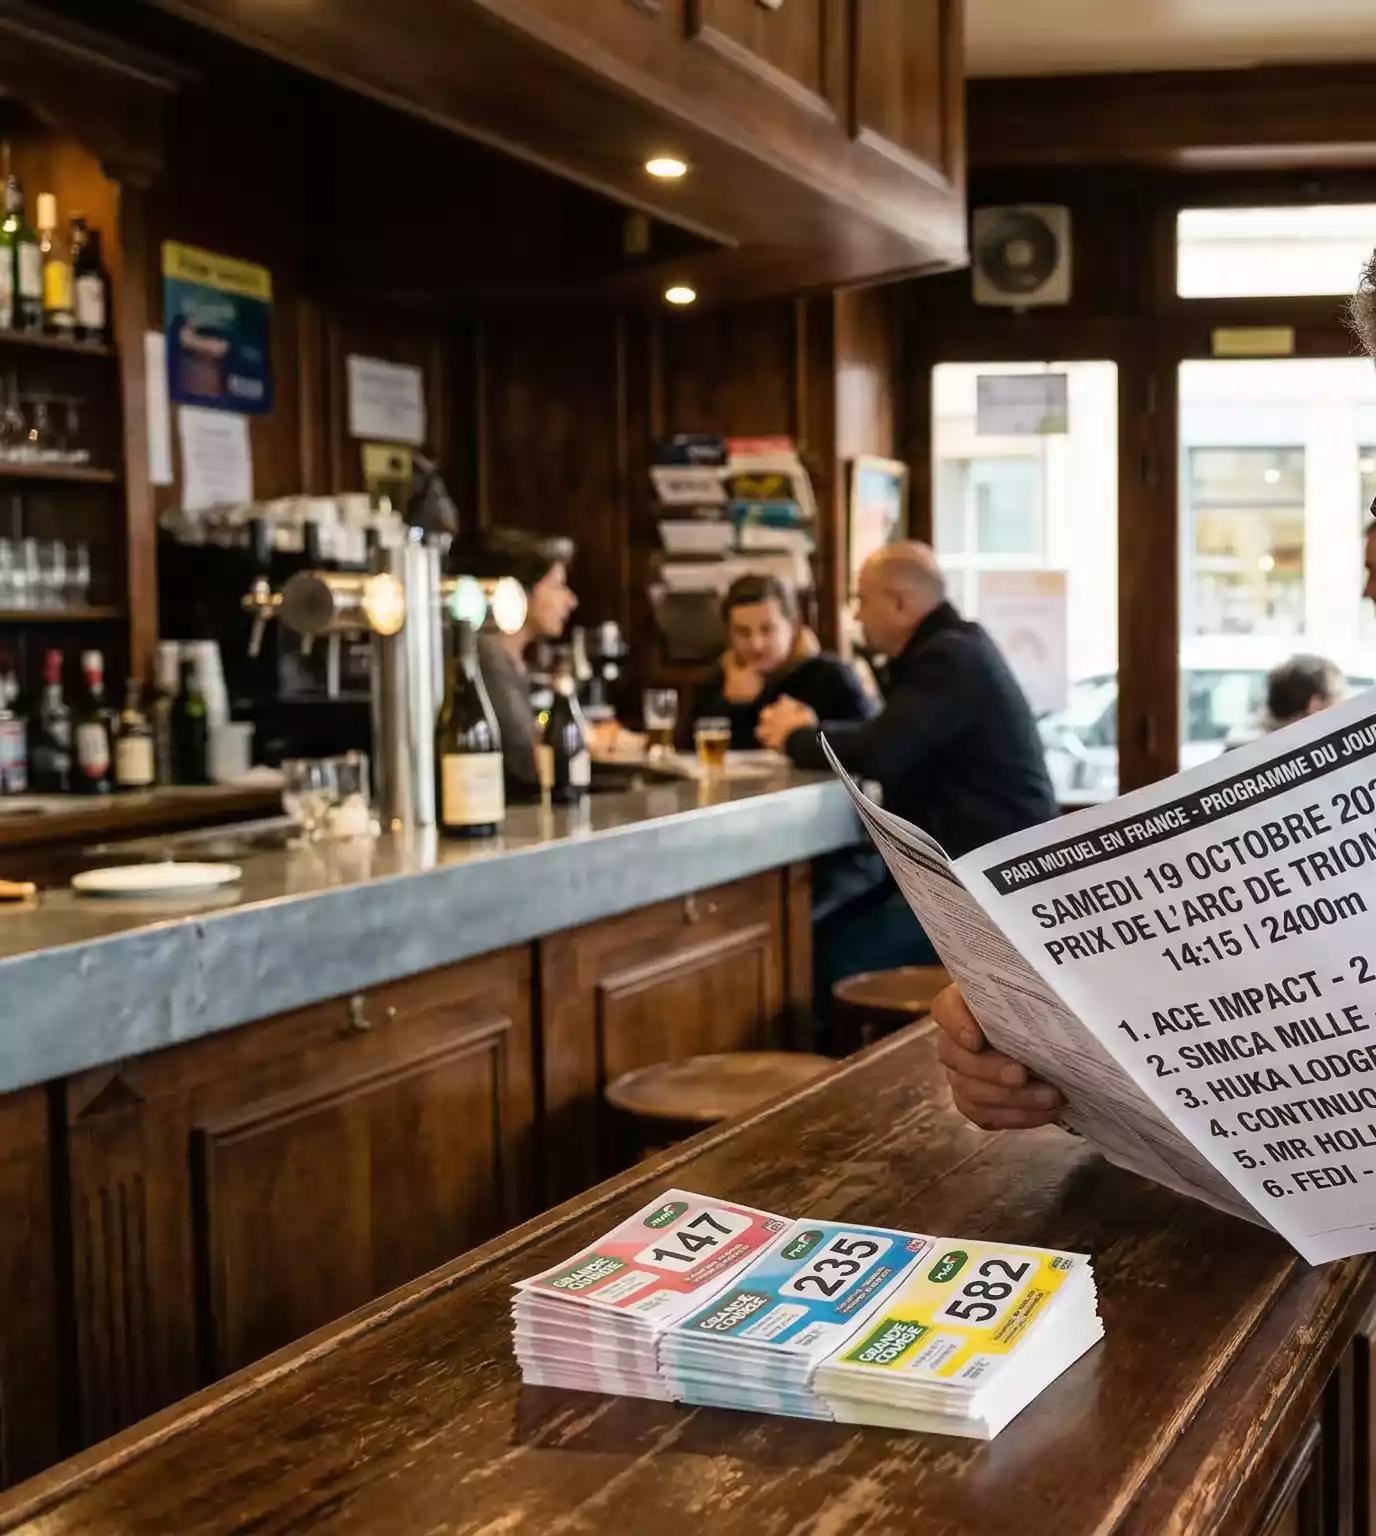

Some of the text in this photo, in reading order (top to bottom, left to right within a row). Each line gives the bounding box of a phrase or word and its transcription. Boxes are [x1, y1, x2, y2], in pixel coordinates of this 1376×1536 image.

[1001, 861, 1039, 886] PARI
[1038, 841, 1101, 873] MUTUEL
[1099, 831, 1125, 852] EN
[1124, 807, 1190, 844] FRANCE
[1200, 756, 1311, 815] PROGRAMME
[1310, 744, 1338, 769] DU
[1031, 875, 1144, 929] SAMEDI
[1143, 862, 1184, 894] 19
[1185, 803, 1332, 880] OCTOBRE
[1043, 926, 1116, 966] PRIX
[1111, 915, 1158, 946] DE
[1242, 867, 1292, 905] DE
[1161, 930, 1243, 972] 14:15
[1261, 892, 1368, 944] 2400m
[1117, 1019, 1150, 1042] 1.
[1151, 1002, 1212, 1036] ACE
[1208, 970, 1323, 1022] IMPACT
[1146, 1054, 1180, 1078] 2.
[1178, 1031, 1277, 1069] SIMCA
[1273, 1004, 1370, 1049] MILLE
[1175, 1087, 1207, 1109] 3.
[1205, 1068, 1293, 1102] HUKA
[1209, 1118, 1237, 1139] 4.
[1232, 1149, 1265, 1169] 5.
[1263, 1138, 1316, 1163] MR
[1262, 1178, 1293, 1198] 6.
[1290, 1164, 1359, 1192] FEDI
[653, 1212, 733, 1263] 147
[793, 1240, 880, 1297] 235
[945, 1259, 1031, 1322] 582
[858, 1322, 908, 1361] GRANDE
